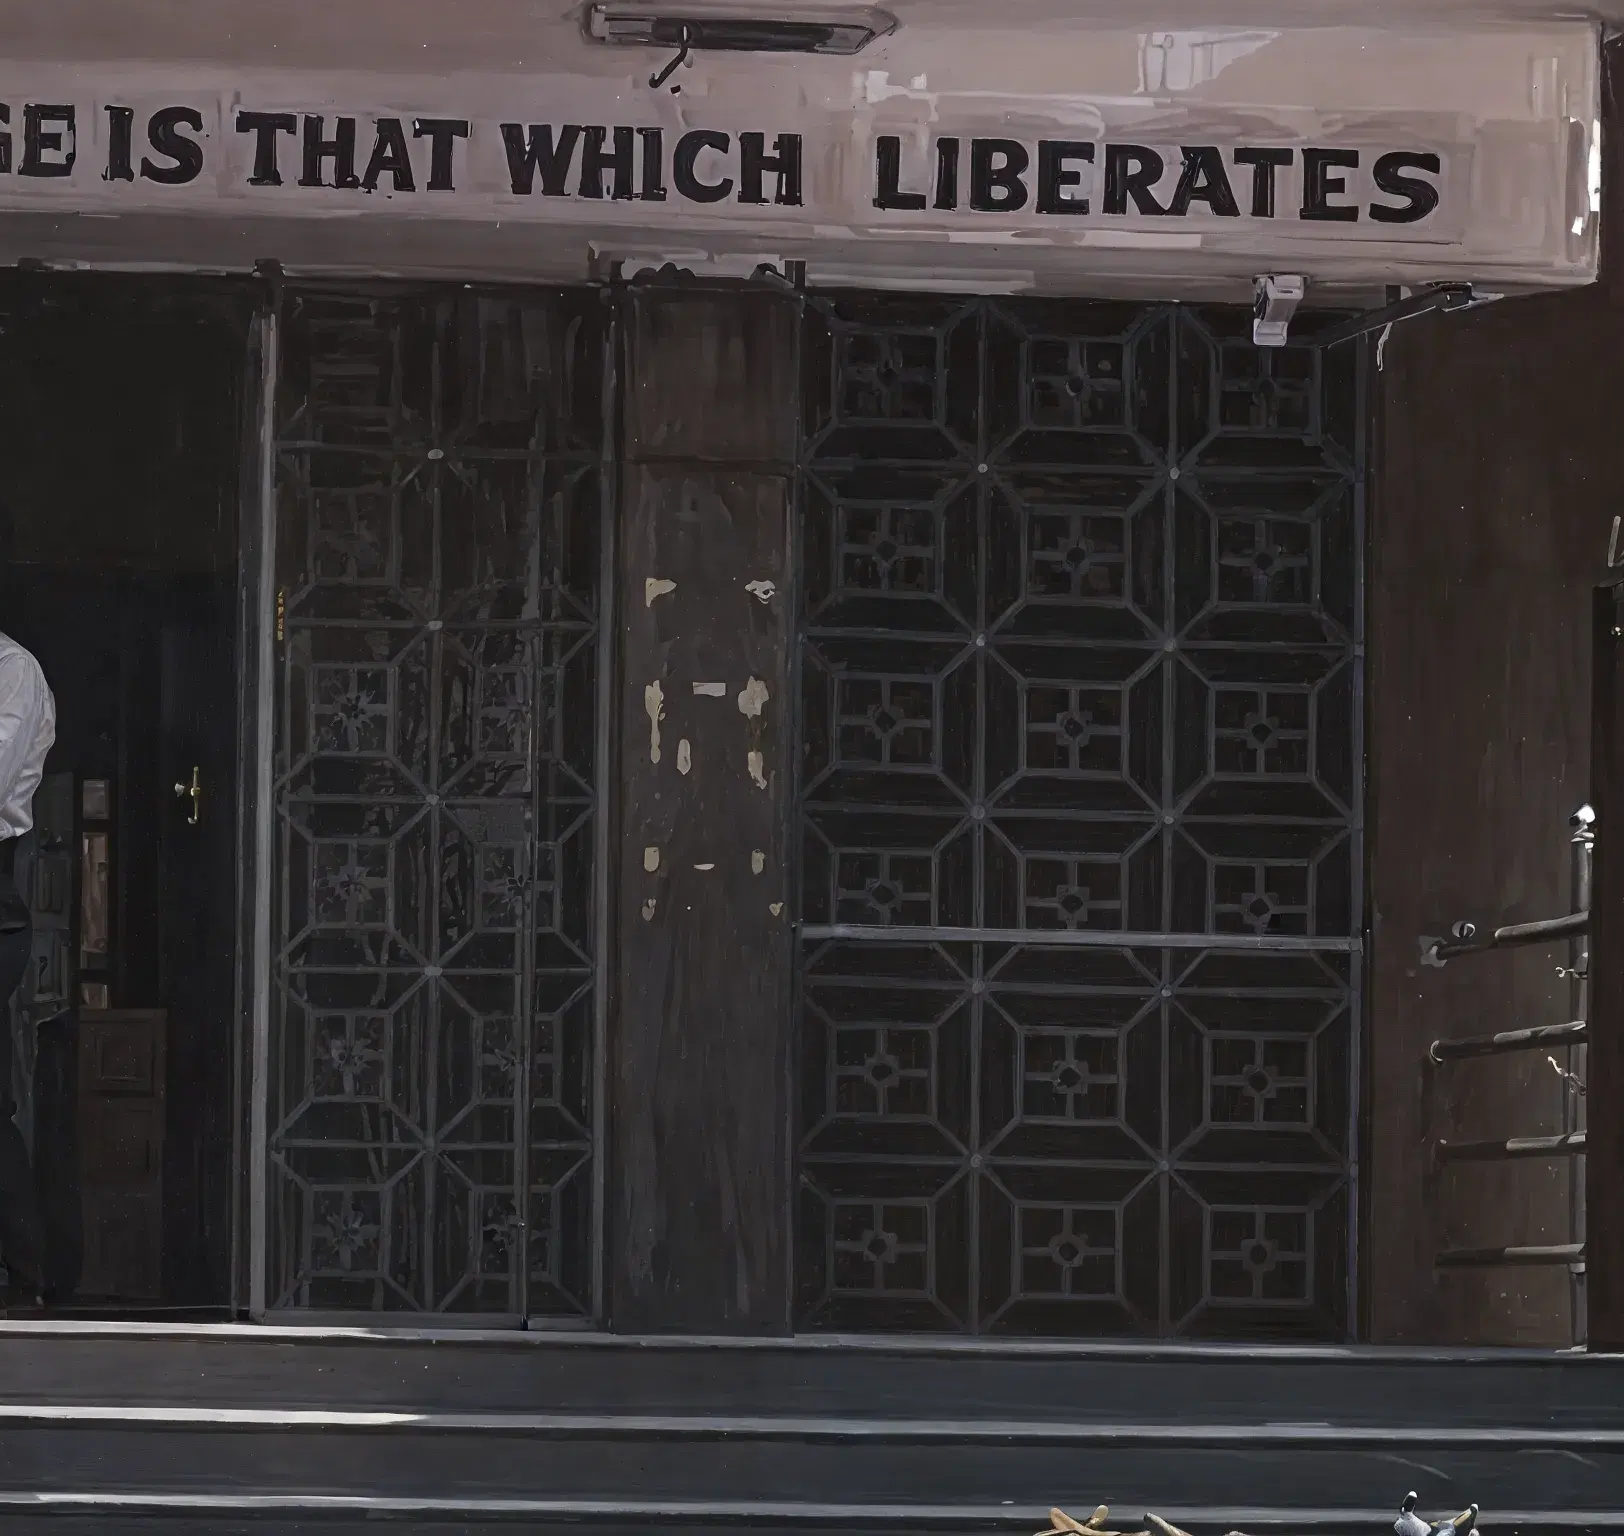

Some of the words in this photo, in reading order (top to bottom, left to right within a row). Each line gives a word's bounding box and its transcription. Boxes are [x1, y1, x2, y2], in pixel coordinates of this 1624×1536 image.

[101, 105, 203, 184] IS
[236, 111, 468, 194] THAT
[500, 124, 805, 207] WHICH
[873, 136, 1440, 223] LIBERATES
